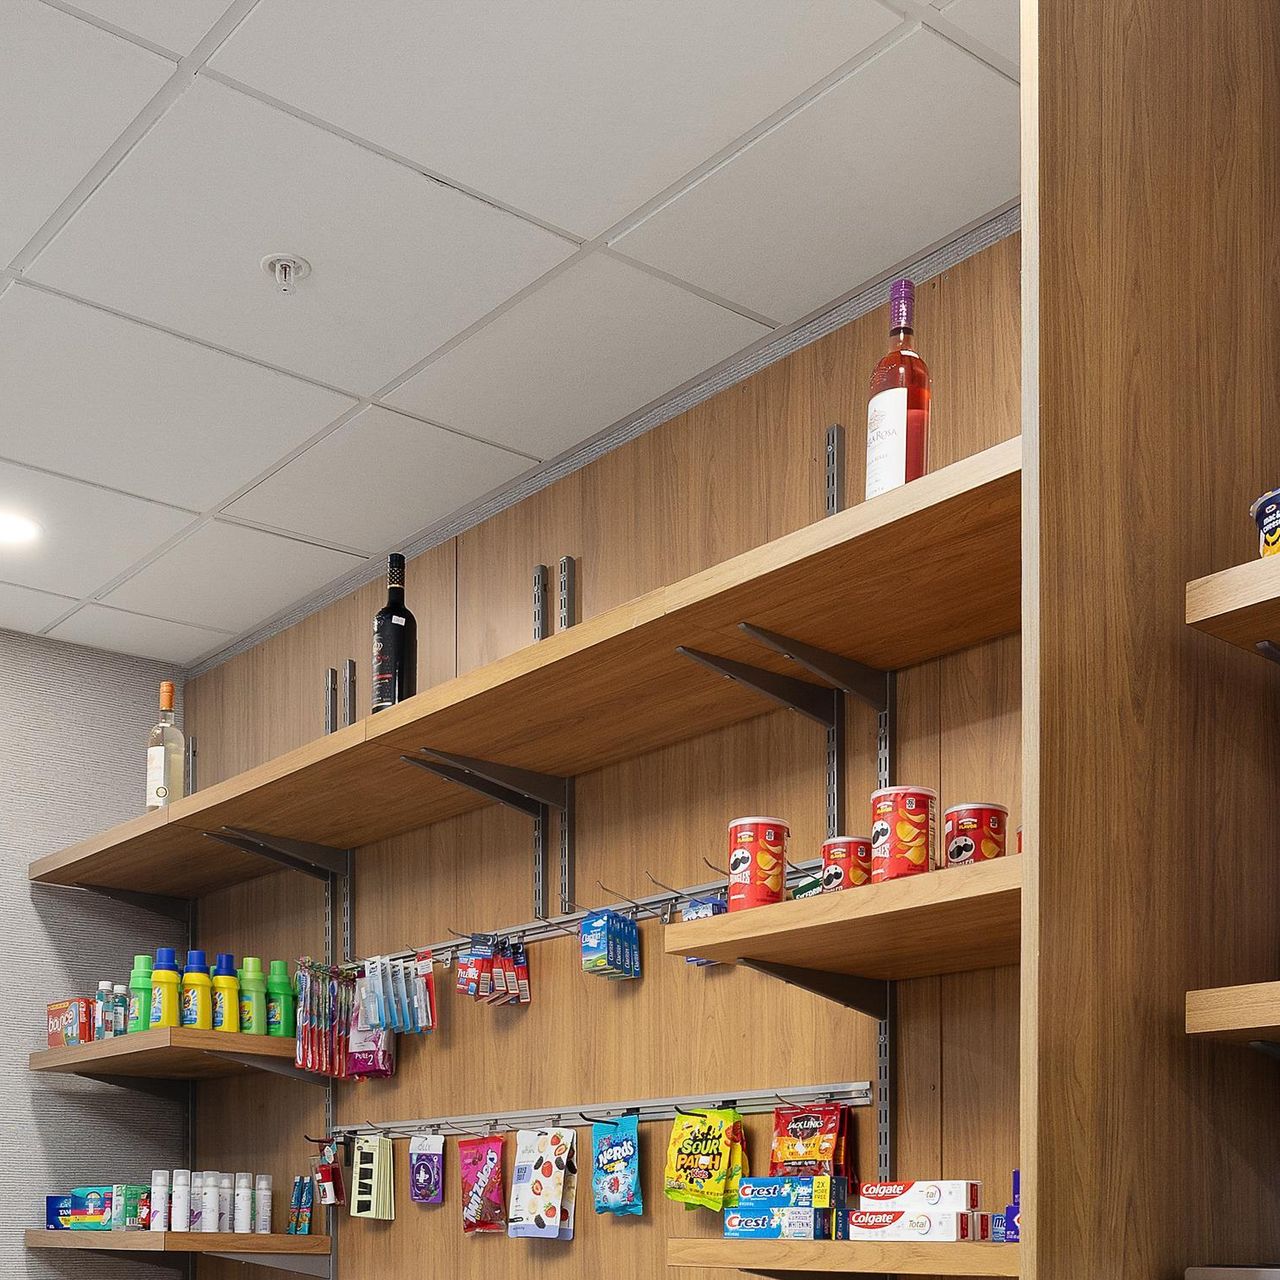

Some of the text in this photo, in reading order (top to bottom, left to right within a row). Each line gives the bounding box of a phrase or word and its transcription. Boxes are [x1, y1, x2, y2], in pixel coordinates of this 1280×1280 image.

[48, 1010, 73, 1034] bounce
[681, 1138, 720, 1155] SOUR
[740, 1184, 779, 1197] Crest
[862, 1184, 905, 1196] Colgate
[727, 1215, 768, 1228] Crest
[851, 1213, 894, 1225] Colgate
[909, 1220, 927, 1229] Total
